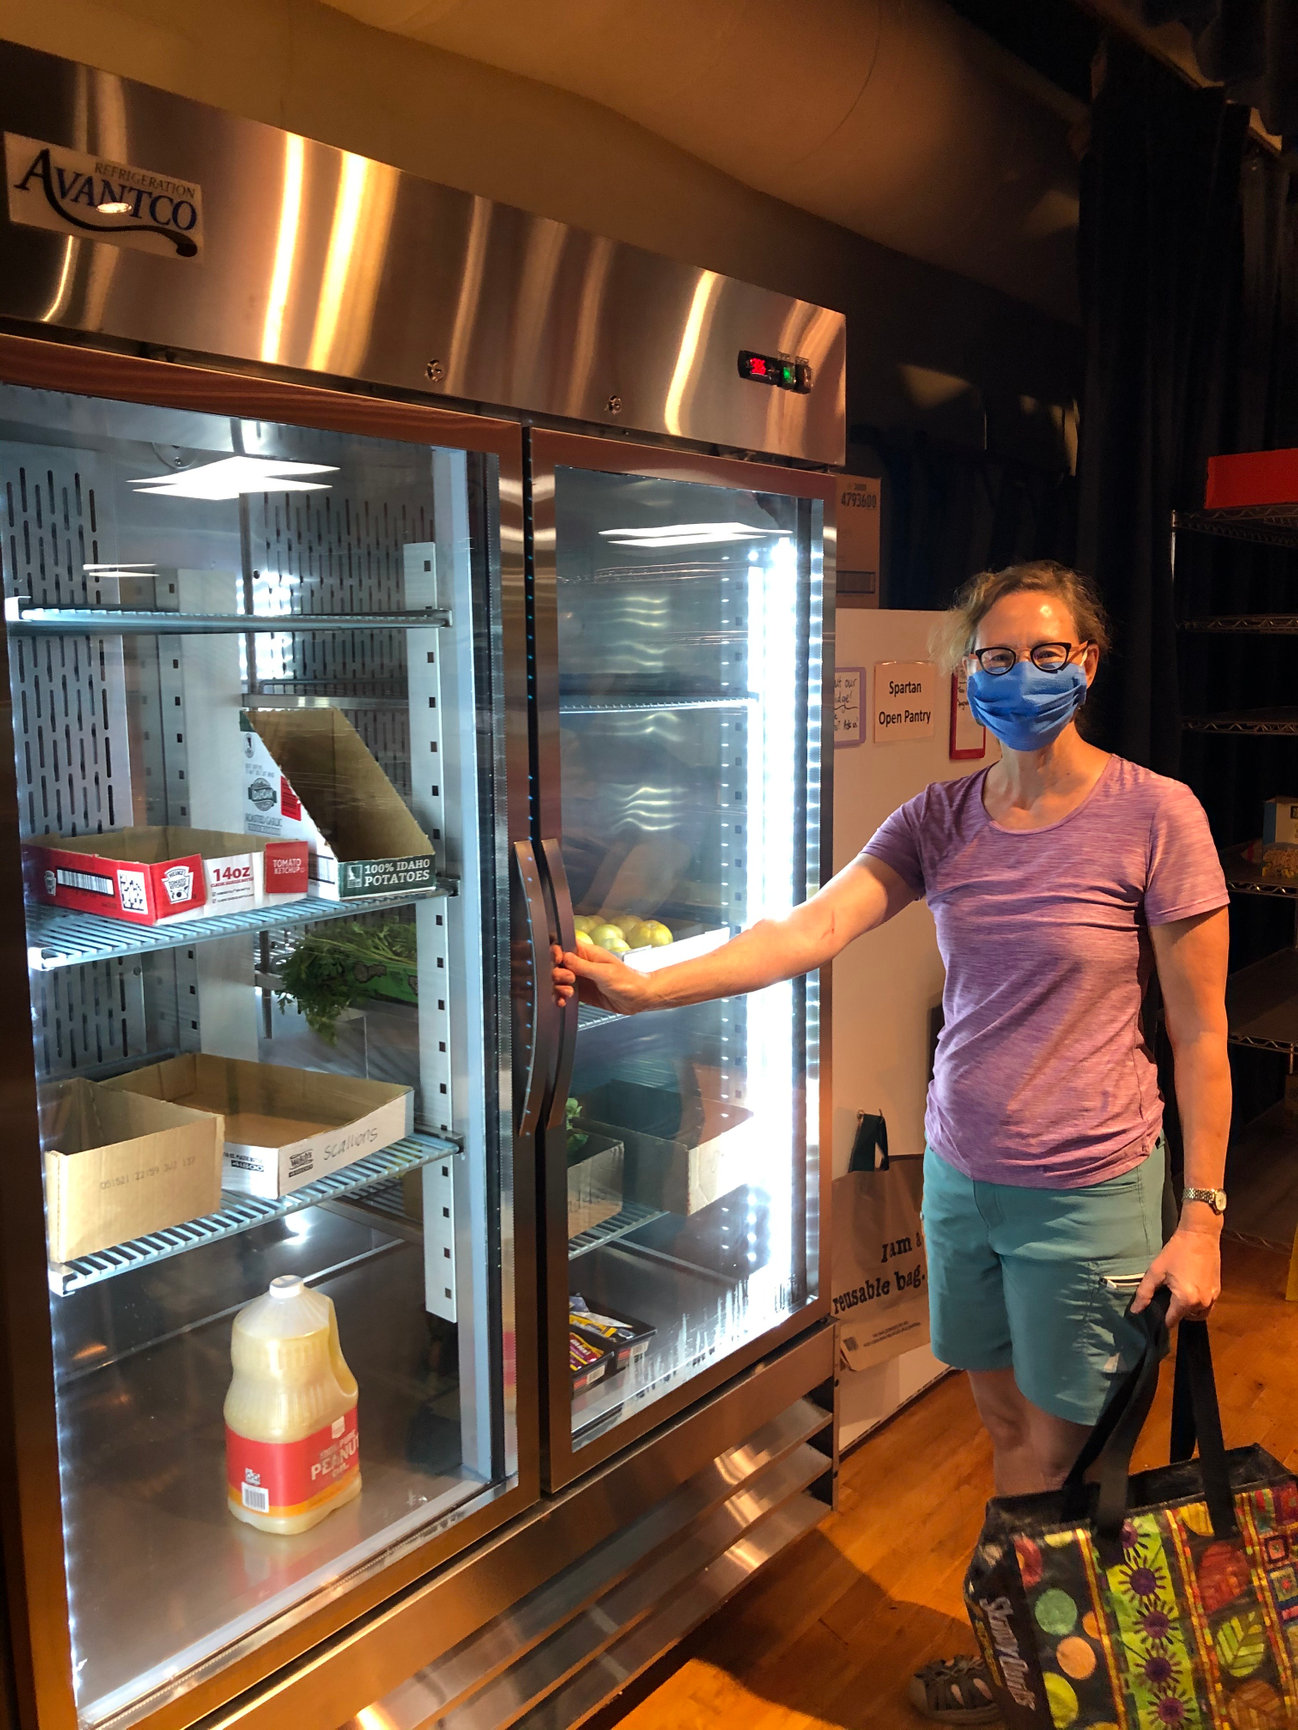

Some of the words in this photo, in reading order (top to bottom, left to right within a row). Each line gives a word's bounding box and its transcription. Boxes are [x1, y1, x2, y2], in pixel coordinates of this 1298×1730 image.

[14, 148, 198, 231] AVANTCO
[95, 162, 196, 199] REFRIGERATION
[889, 680, 922, 697] Spartan
[878, 711, 902, 728] Open
[904, 709, 932, 725] Pantry
[272, 858, 302, 868] TOMATO
[273, 867, 300, 875] KETCHUP
[364, 862, 395, 874] 100%
[396, 858, 430, 871] IDAHO
[364, 869, 431, 887] POTATOES
[832, 1277, 891, 1315] reusable
[894, 1264, 925, 1291] bag.
